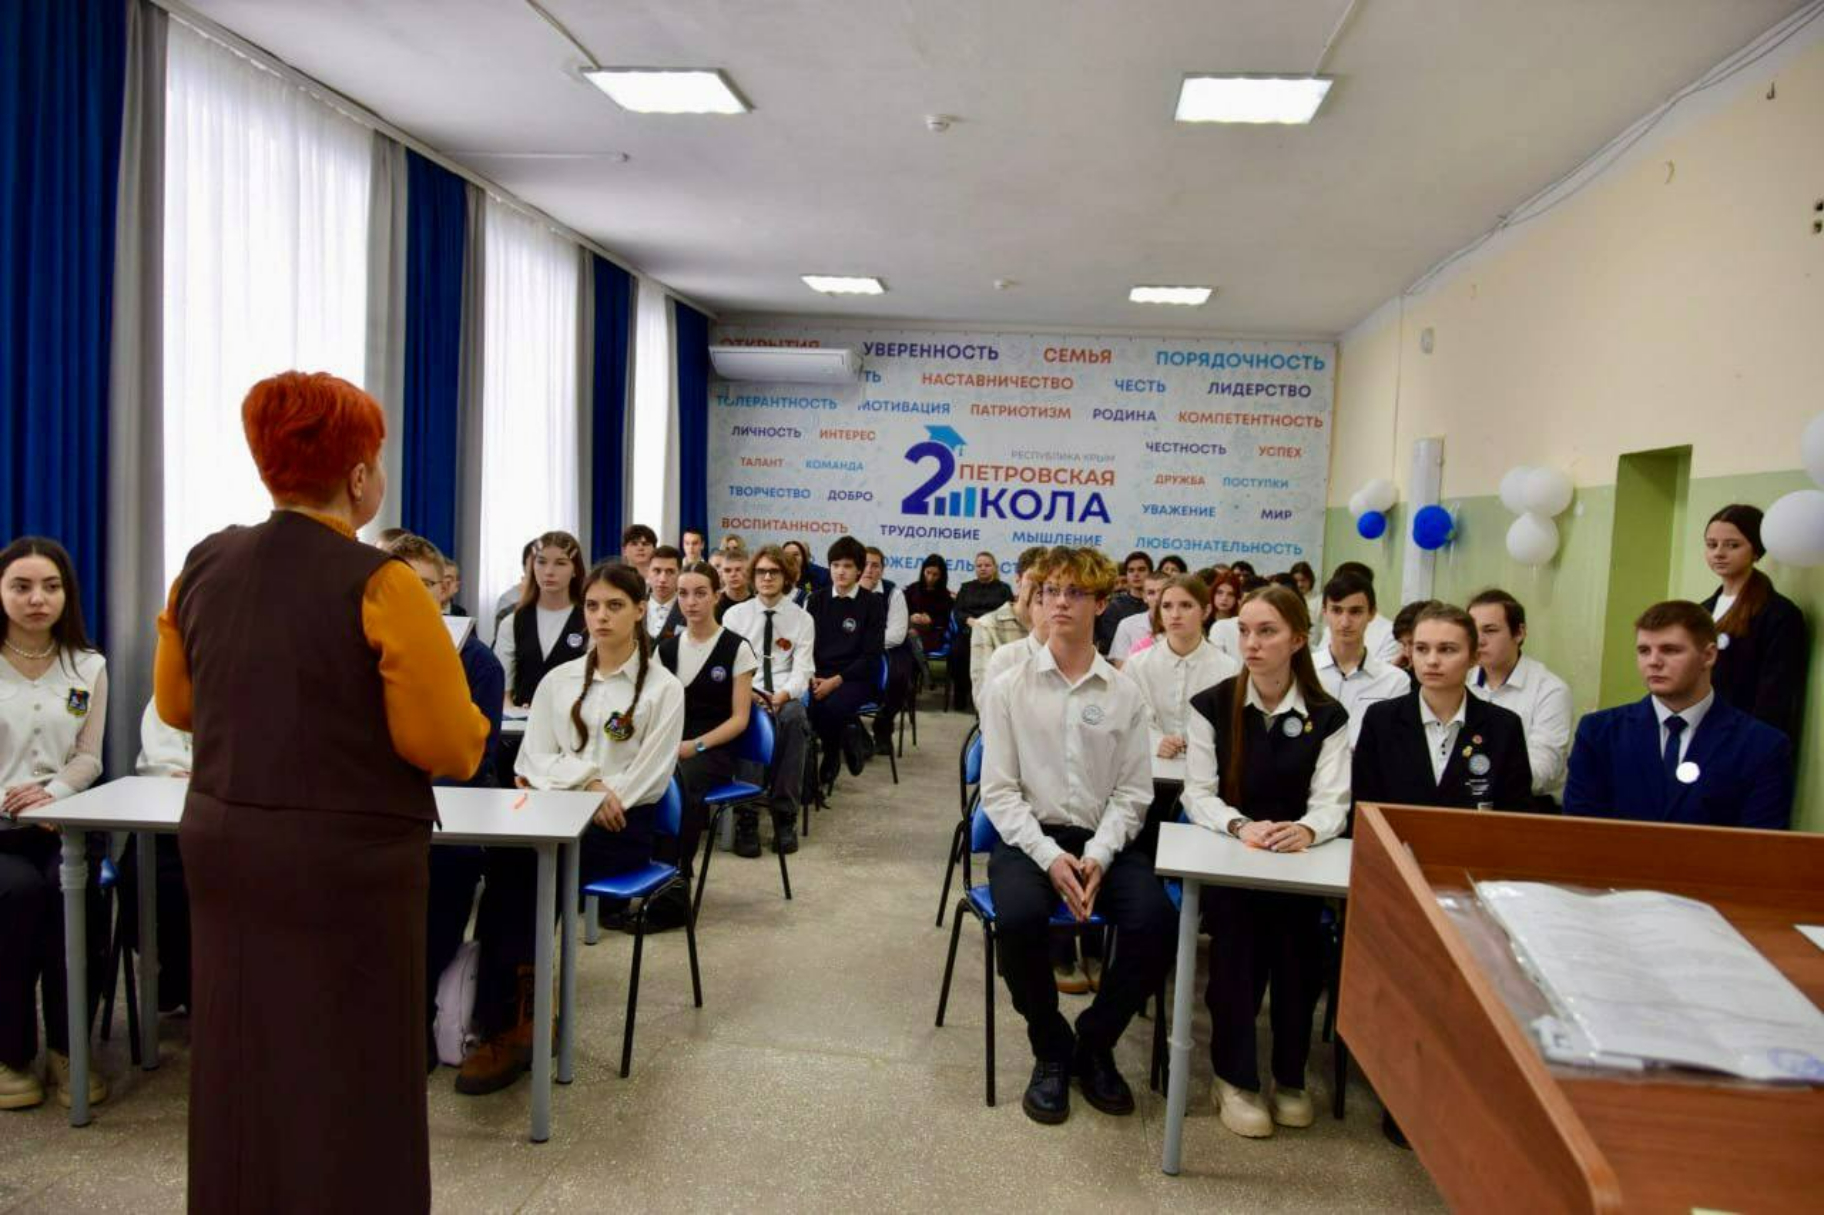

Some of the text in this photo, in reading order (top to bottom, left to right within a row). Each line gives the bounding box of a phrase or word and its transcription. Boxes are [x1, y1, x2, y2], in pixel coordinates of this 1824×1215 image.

[863, 342, 999, 361] УВЕРЕННОСТЬ
[1043, 348, 1112, 364] СЕМЬЯ
[1156, 351, 1326, 371] ПОРЯДОЧНОСТЬ
[921, 372, 1074, 390] НАСТАВНИЧЕСТВО
[1115, 379, 1166, 393] ЧЕСТЬ
[1208, 382, 1312, 398] ЛИДЕРСТВО
[717, 395, 838, 410] ТОЛЕРАНТНОСТЬ
[970, 404, 1072, 419] ПАТРИОТИЗМ
[1092, 408, 1157, 422] РОДИНА
[1178, 411, 1324, 428] КОМПЕТЕНТНОСТЬ
[731, 426, 802, 440] ЛИЧНОСТЬ
[820, 429, 876, 441] ИНТЕРЕС
[1011, 450, 1081, 462] РЕСПУБЛИКА
[1145, 442, 1228, 455] ЧЕСТНОСТЬ
[1258, 446, 1302, 458] УСПЕХ
[740, 457, 785, 468] ТАЛАНТ
[805, 459, 864, 471] КОМАНДА
[901, 441, 955, 515] 2
[959, 464, 1116, 486] ПЕТРОВСКАЯ
[1155, 474, 1206, 486] ДРУЖБА
[1222, 476, 1289, 489] ПОСТУПКИ
[729, 485, 812, 499] ТВОРЧЕСТВО
[827, 490, 874, 501] ДОБРО
[1141, 503, 1216, 518] УВАЖЕНИЕ
[1260, 509, 1293, 521] МИР
[721, 517, 849, 534] ВОСПИТАННОСТЬ
[880, 524, 980, 541] ТРУДОЛЮБИЕ
[1012, 531, 1103, 546] МЫШЛЕНИЕ
[1135, 536, 1304, 556] ЛЮБОЗНАТЕЛЬНОСТЬ
